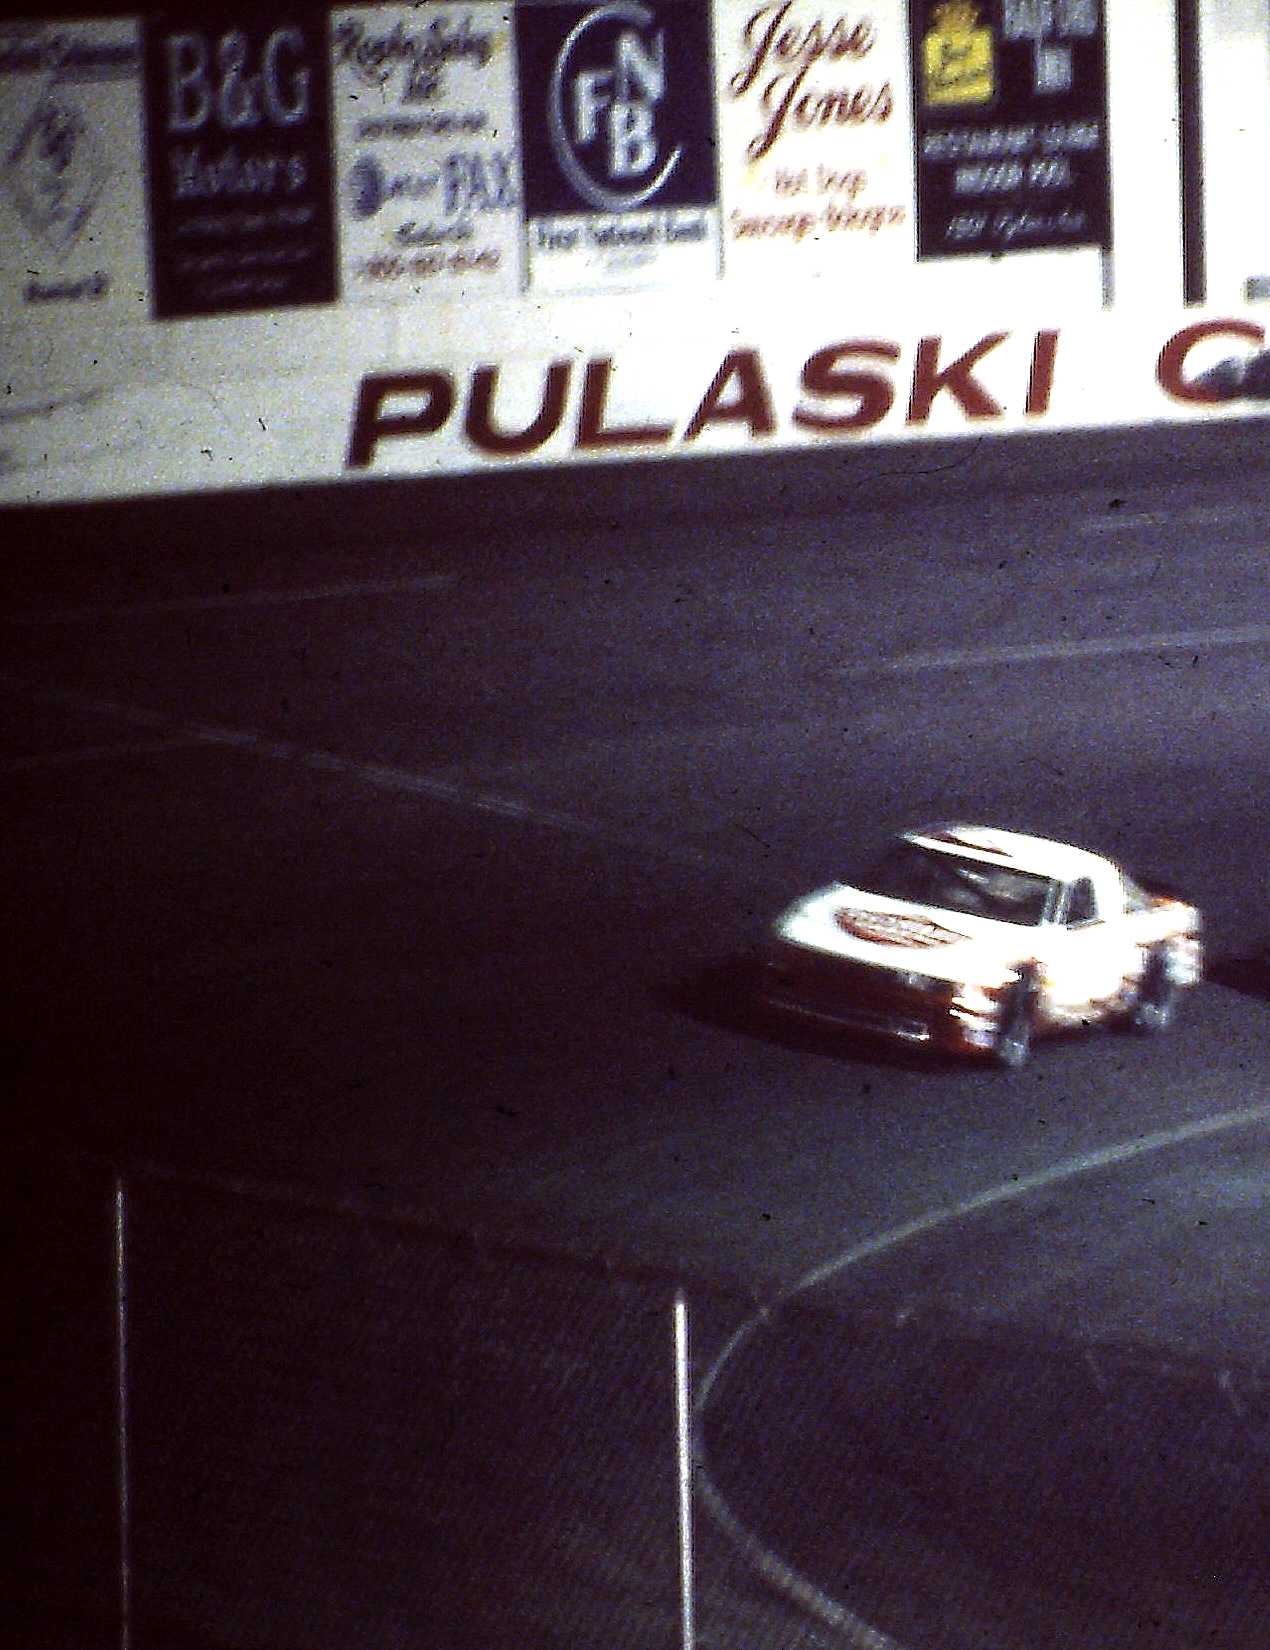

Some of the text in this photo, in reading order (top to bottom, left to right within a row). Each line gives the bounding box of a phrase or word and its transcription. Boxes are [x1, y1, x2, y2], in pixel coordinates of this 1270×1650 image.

[167, 30, 311, 130] B&G
[731, 0, 876, 94] Jesse
[747, 63, 894, 162] Jones
[344, 328, 1062, 469] PULASKI
